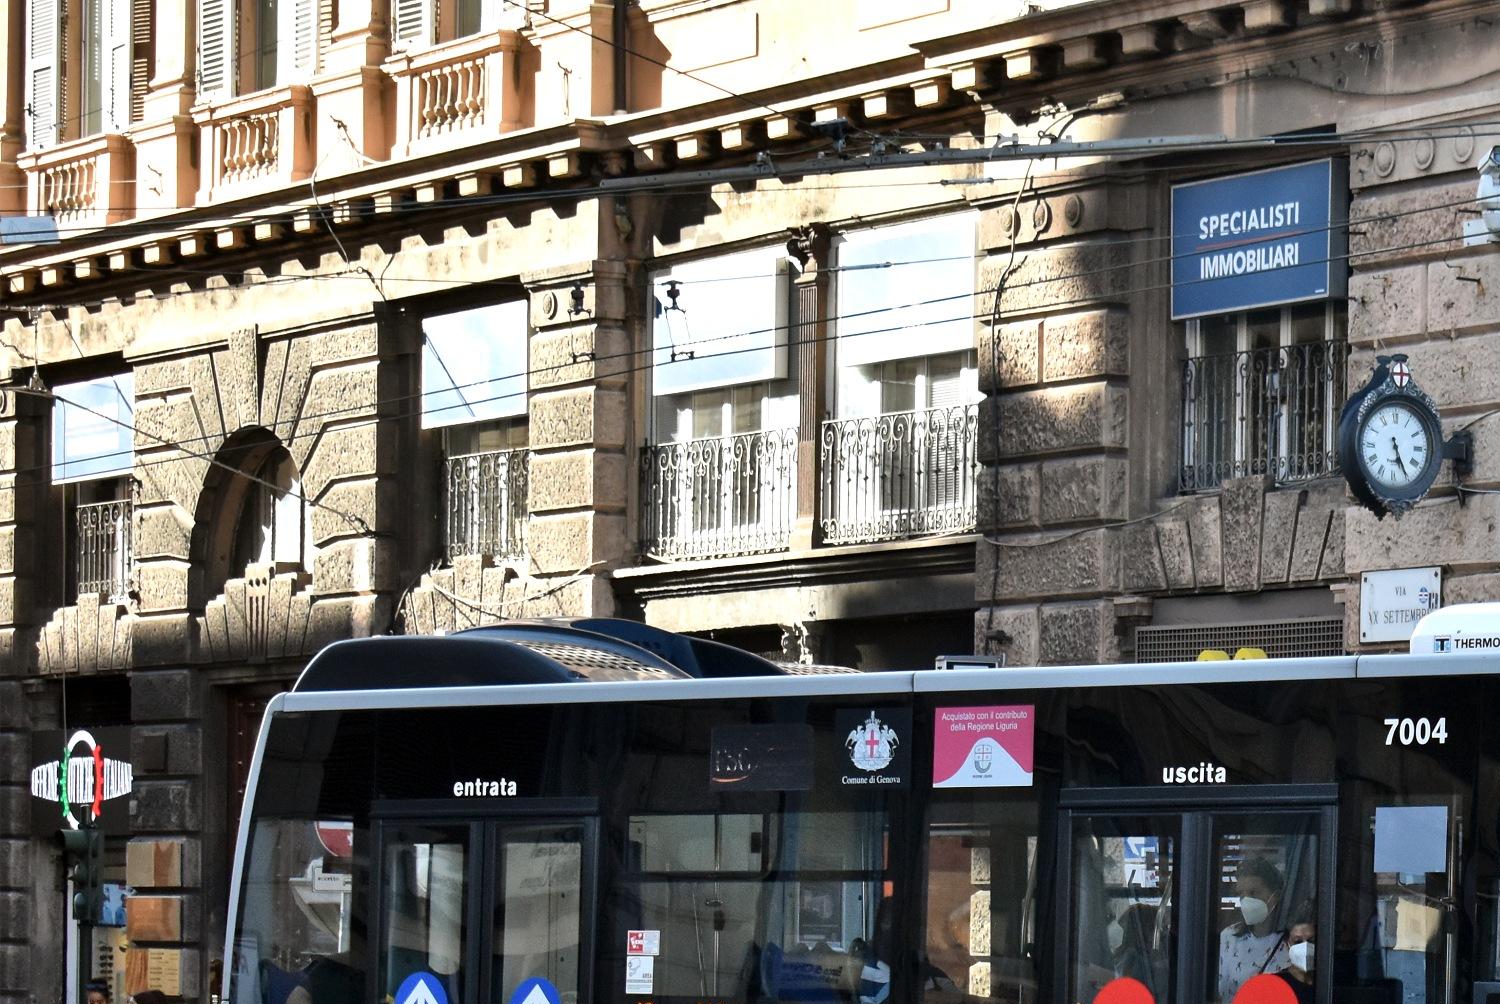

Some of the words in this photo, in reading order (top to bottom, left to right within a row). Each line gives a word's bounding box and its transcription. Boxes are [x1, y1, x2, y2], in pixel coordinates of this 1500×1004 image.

[1199, 201, 1299, 240] SPECIALISTI
[1200, 242, 1299, 280] IMMOBILIARI
[1395, 586, 1407, 597] VIA
[1454, 637, 1500, 649] THERMO
[942, 712, 975, 722] Acquistato
[995, 710, 1028, 720] contributo
[950, 723, 966, 732] della
[967, 722, 994, 733] Regione
[996, 721, 1018, 732] Liguria
[1384, 717, 1448, 746] 7004
[841, 775, 867, 785] Comune
[870, 775, 876, 784] di
[877, 775, 901, 784] Genova
[1162, 762, 1227, 783] uscita
[453, 777, 517, 797] entrata
